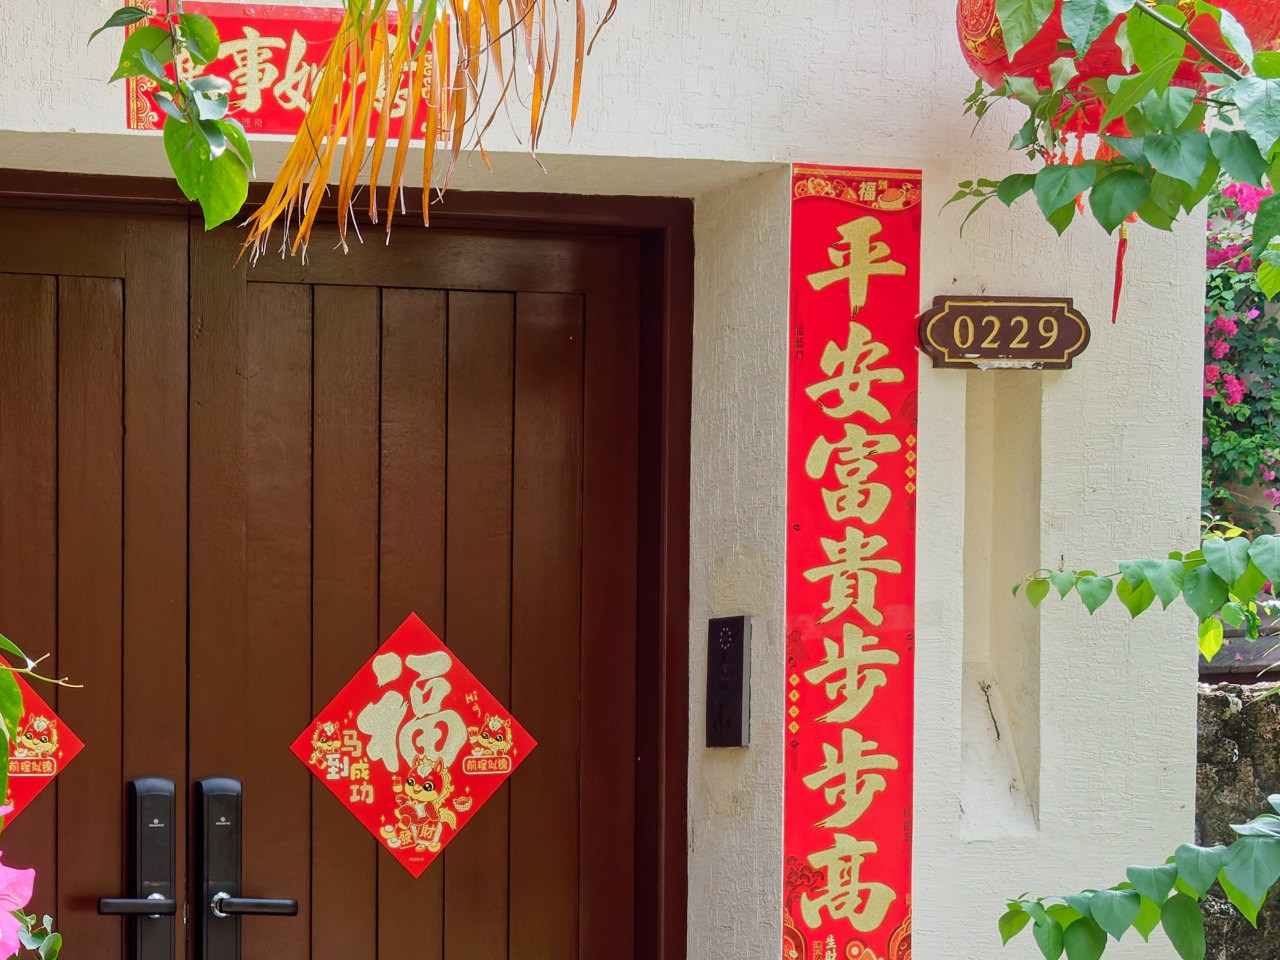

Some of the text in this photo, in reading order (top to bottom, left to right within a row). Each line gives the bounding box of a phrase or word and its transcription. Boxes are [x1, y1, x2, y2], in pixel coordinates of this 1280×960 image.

[954, 315, 1059, 350] 0229
[800, 215, 907, 933] 平安富貴步步高
[356, 651, 468, 773] 福
[465, 690, 478, 704] Hi
[326, 730, 375, 804] 马到成功
